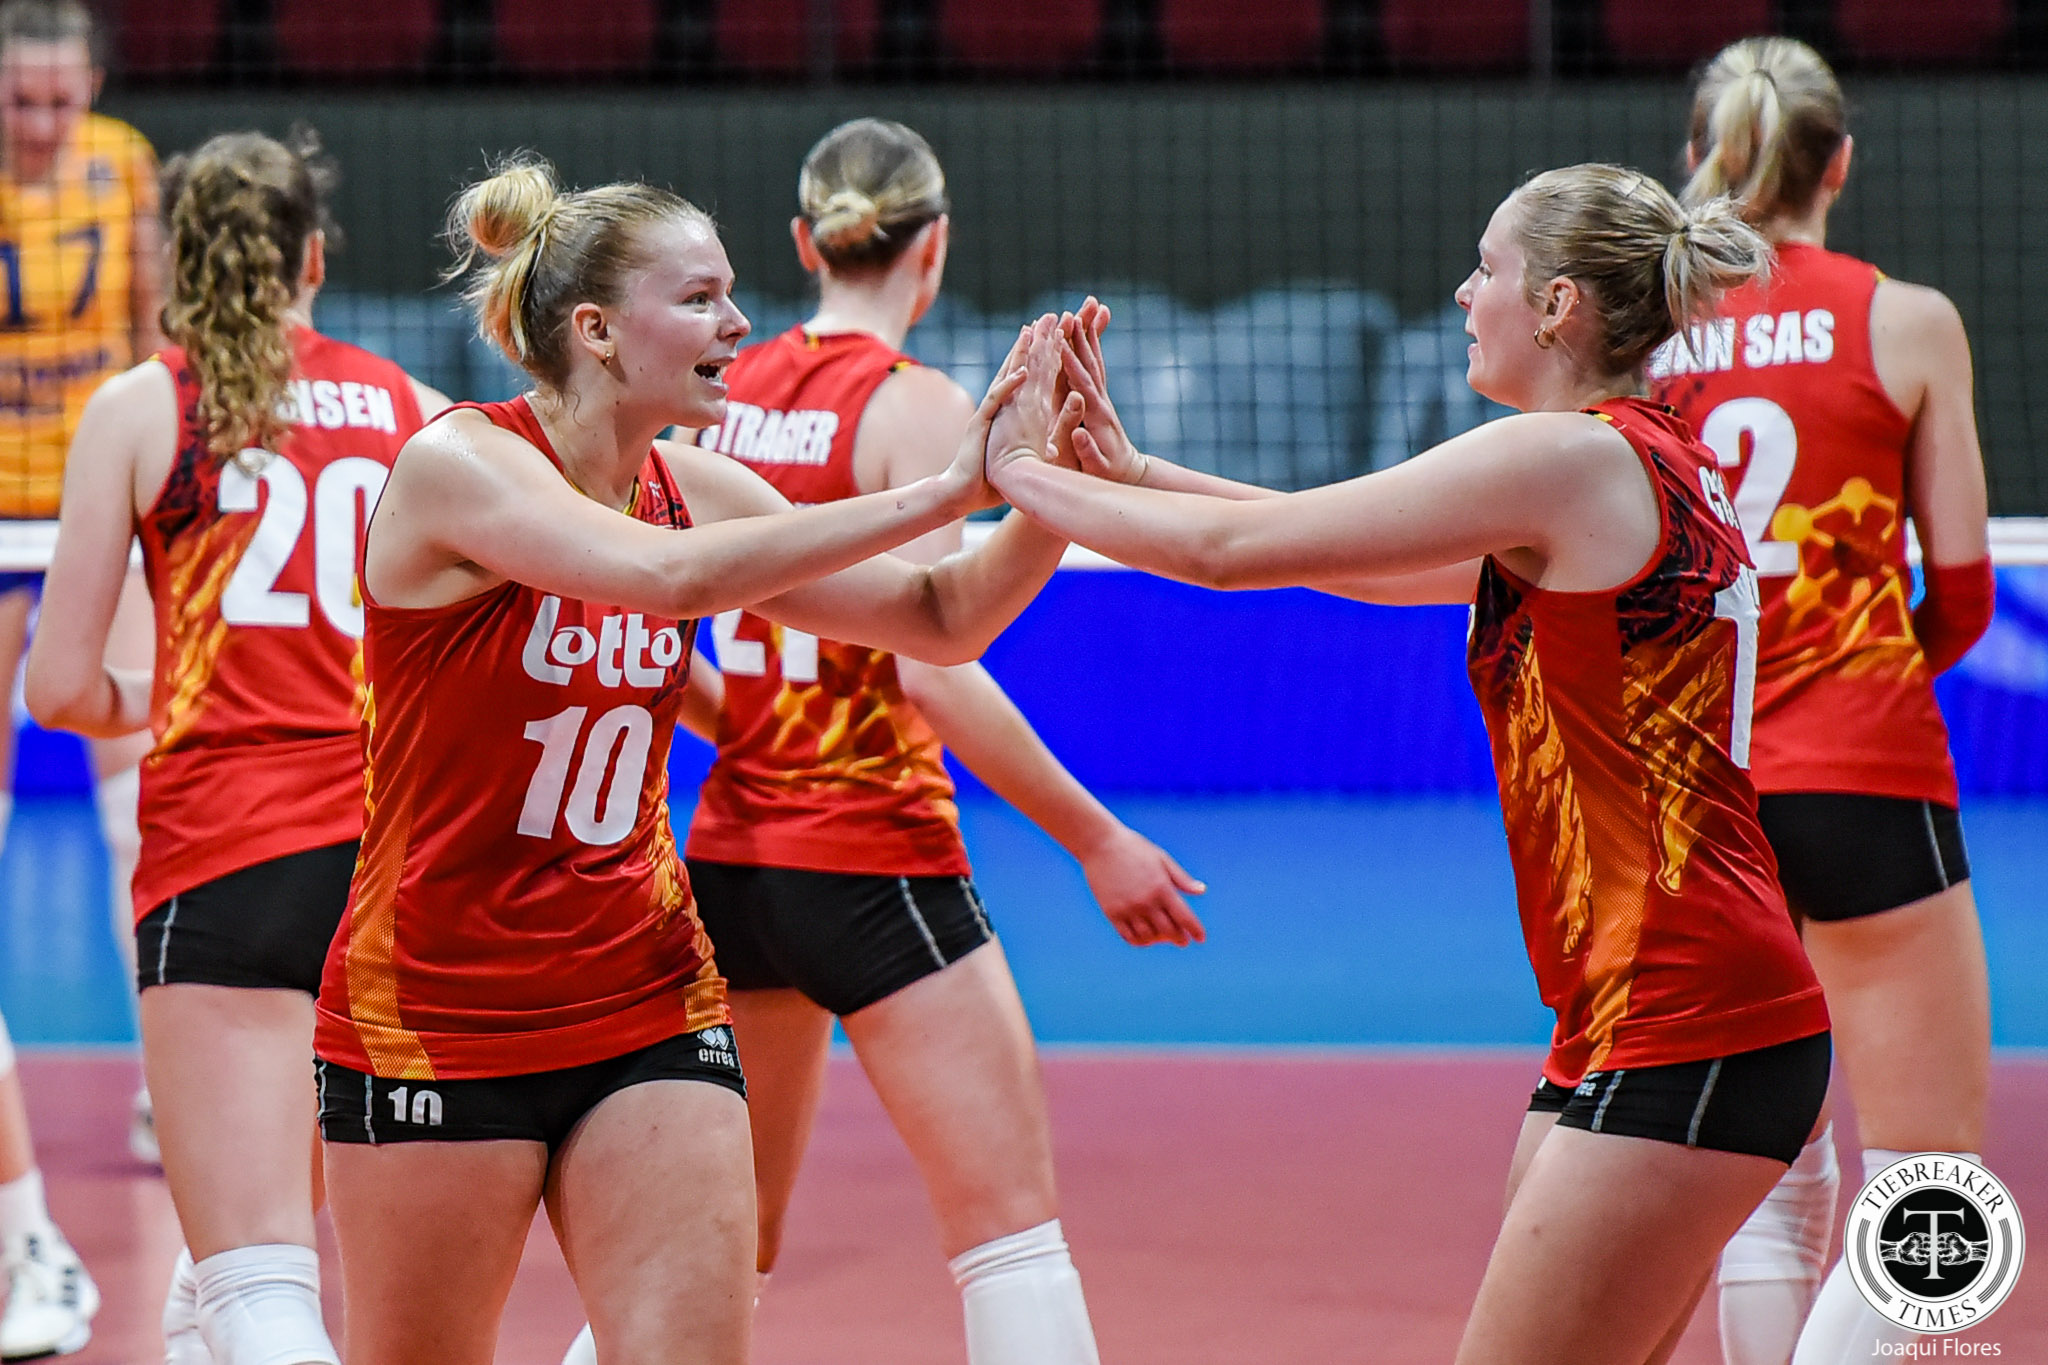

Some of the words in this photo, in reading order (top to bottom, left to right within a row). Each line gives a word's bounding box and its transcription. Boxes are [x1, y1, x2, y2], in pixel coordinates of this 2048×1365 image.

[1744, 308, 1835, 368] SAS
[274, 379, 398, 436] NSEN
[1701, 396, 1800, 578] 2
[217, 447, 393, 638] 20
[521, 594, 682, 688] Lotto
[516, 703, 654, 846] 10
[387, 1085, 444, 1127] 10
